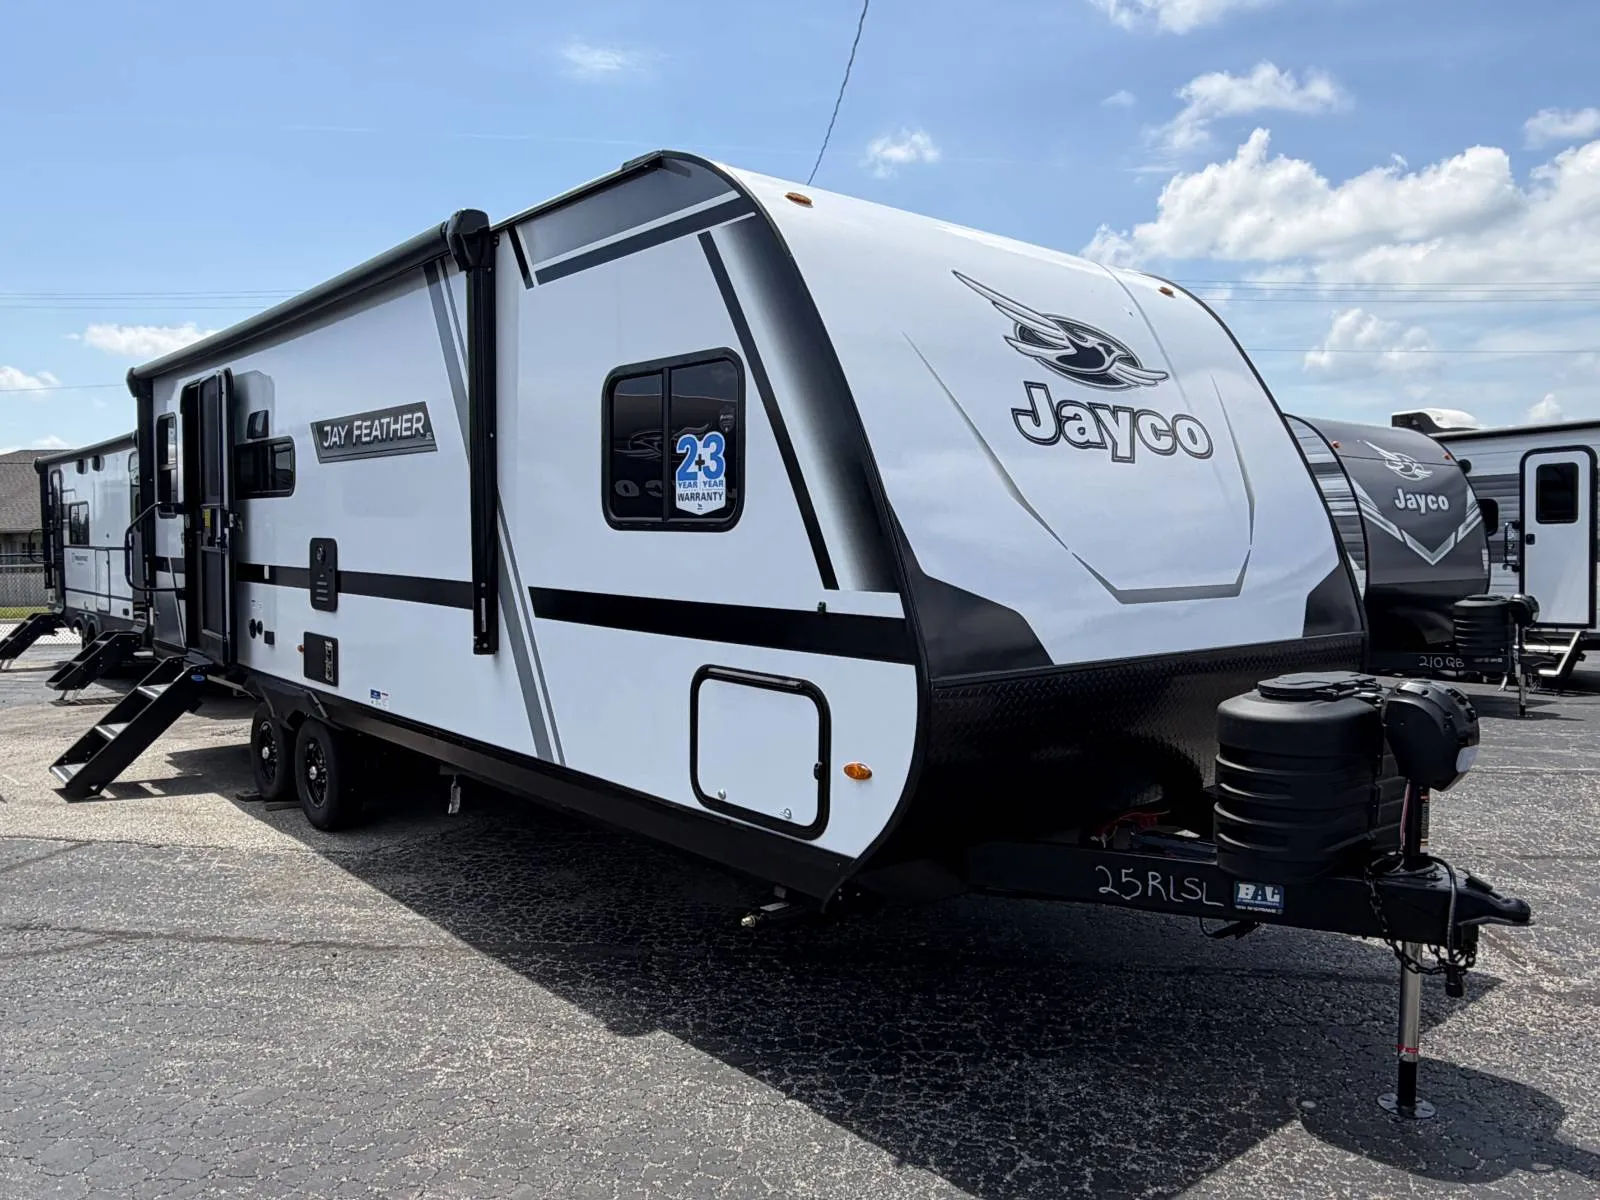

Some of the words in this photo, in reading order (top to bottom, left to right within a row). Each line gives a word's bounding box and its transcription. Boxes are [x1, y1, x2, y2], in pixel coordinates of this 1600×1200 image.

[322, 424, 349, 448] JAY
[352, 412, 425, 443] FEATHER
[1011, 381, 1213, 464] Jayco
[677, 491, 724, 501] WARRANTY
[678, 481, 698, 489] YEAR
[702, 480, 724, 488] YEAR
[1394, 487, 1450, 514] Jayco
[1095, 865, 1225, 907] 25RLSL
